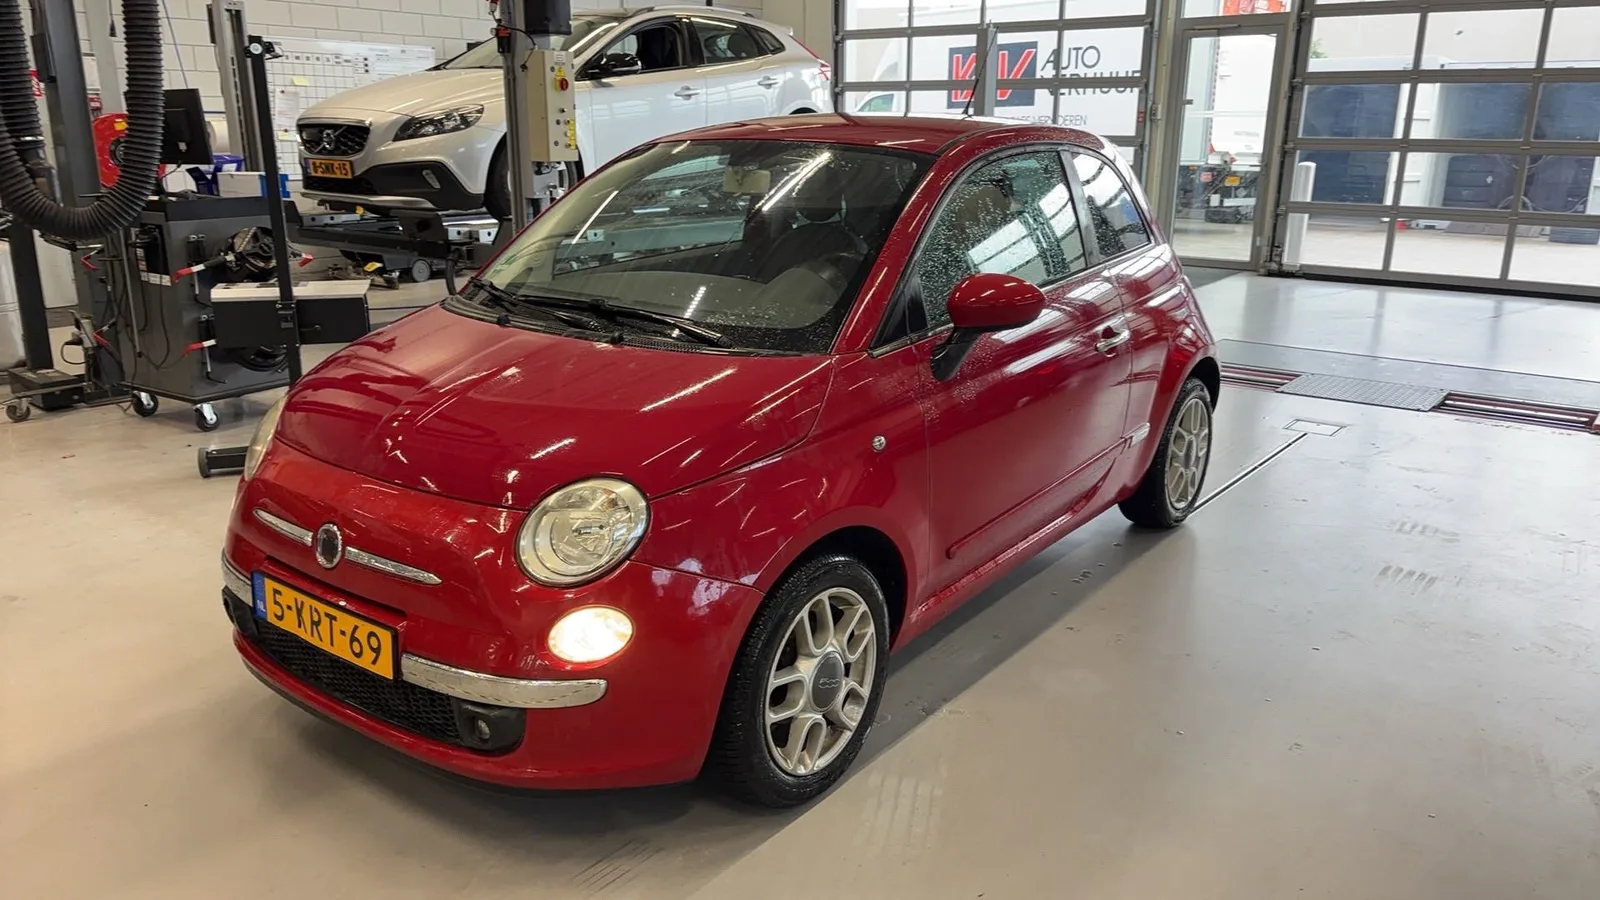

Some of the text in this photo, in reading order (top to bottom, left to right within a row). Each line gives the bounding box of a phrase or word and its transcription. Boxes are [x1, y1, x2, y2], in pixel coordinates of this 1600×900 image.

[952, 49, 1036, 102] KV
[1040, 46, 1101, 71] AUTO
[1040, 70, 1141, 96] RHUU
[272, 588, 382, 666] 5-KRT-69
